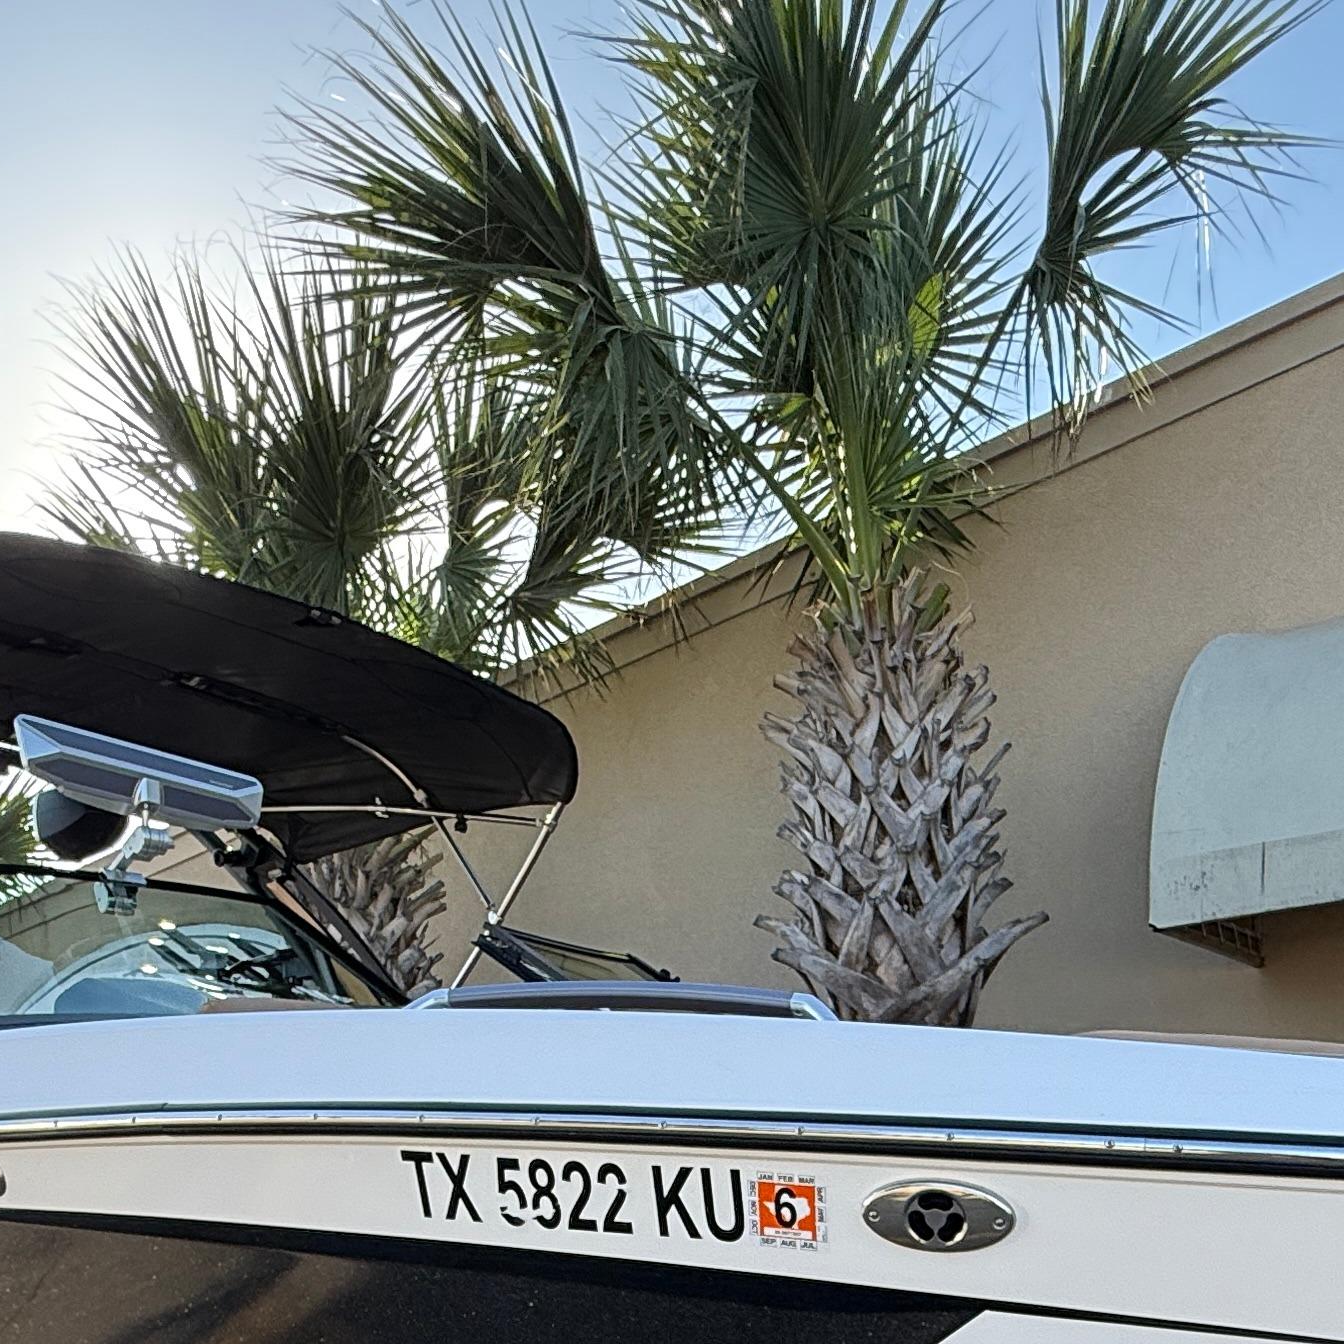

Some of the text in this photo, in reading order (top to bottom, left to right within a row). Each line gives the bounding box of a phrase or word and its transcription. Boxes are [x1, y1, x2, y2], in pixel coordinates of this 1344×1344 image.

[400, 1150, 745, 1242] TX 5822 KU
[774, 1187, 797, 1229] 6
